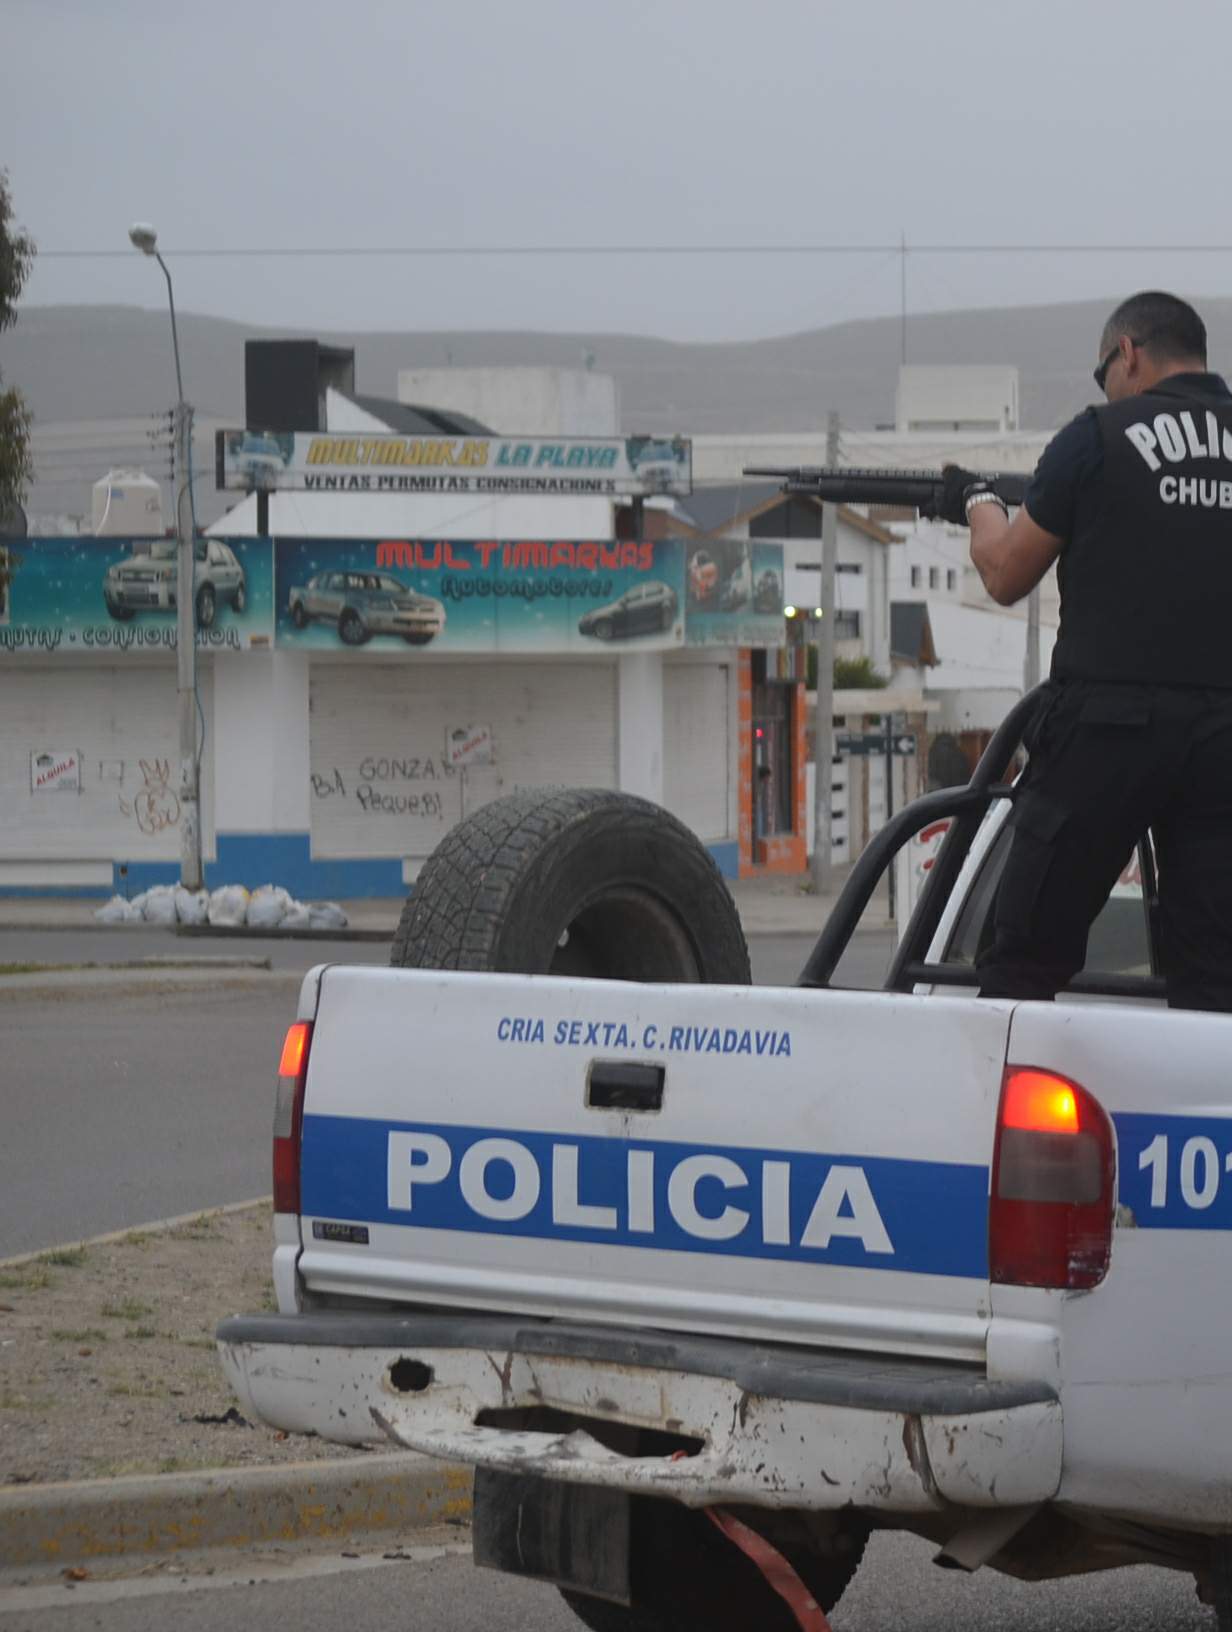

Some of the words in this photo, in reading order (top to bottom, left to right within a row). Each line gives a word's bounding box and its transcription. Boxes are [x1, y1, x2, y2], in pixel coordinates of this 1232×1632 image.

[496, 441, 532, 467] LA
[533, 443, 620, 469] PLAYA
[303, 474, 371, 491] VENTAS
[377, 475, 470, 492] PERMUTAS
[36, 757, 76, 785] ALQUILA
[497, 1017, 546, 1044] CRIA
[554, 1020, 637, 1049] SEXTA.
[386, 1129, 896, 1255] POLICIA
